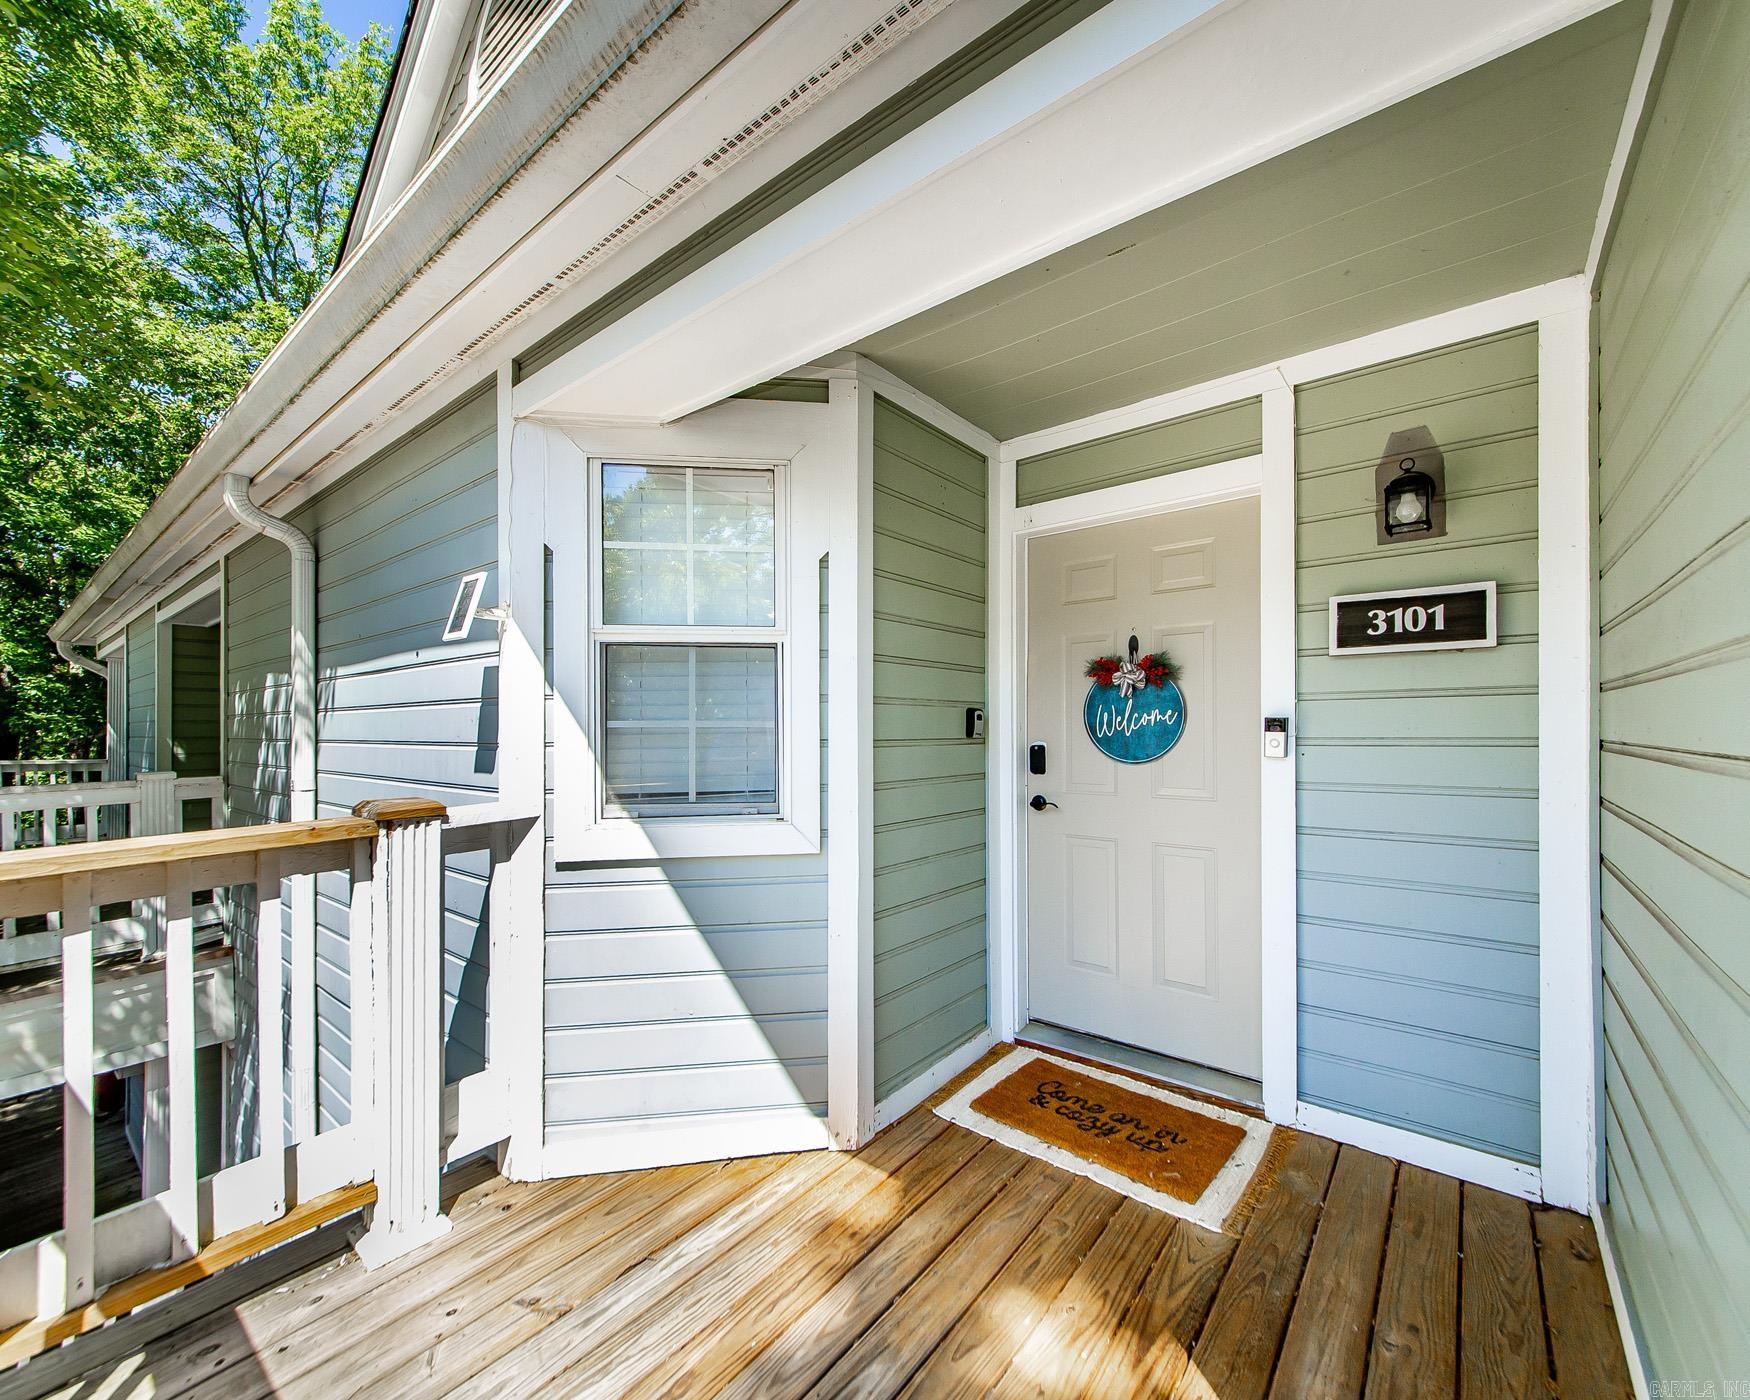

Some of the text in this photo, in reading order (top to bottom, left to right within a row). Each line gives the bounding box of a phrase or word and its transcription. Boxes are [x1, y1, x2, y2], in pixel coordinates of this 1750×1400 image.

[1366, 603, 1445, 636] 3101
[1096, 698, 1178, 738] Welcome
[1028, 1094, 1170, 1153] & cozy up
[1037, 1080, 1106, 1114] Come
[1108, 1112, 1150, 1131] on
